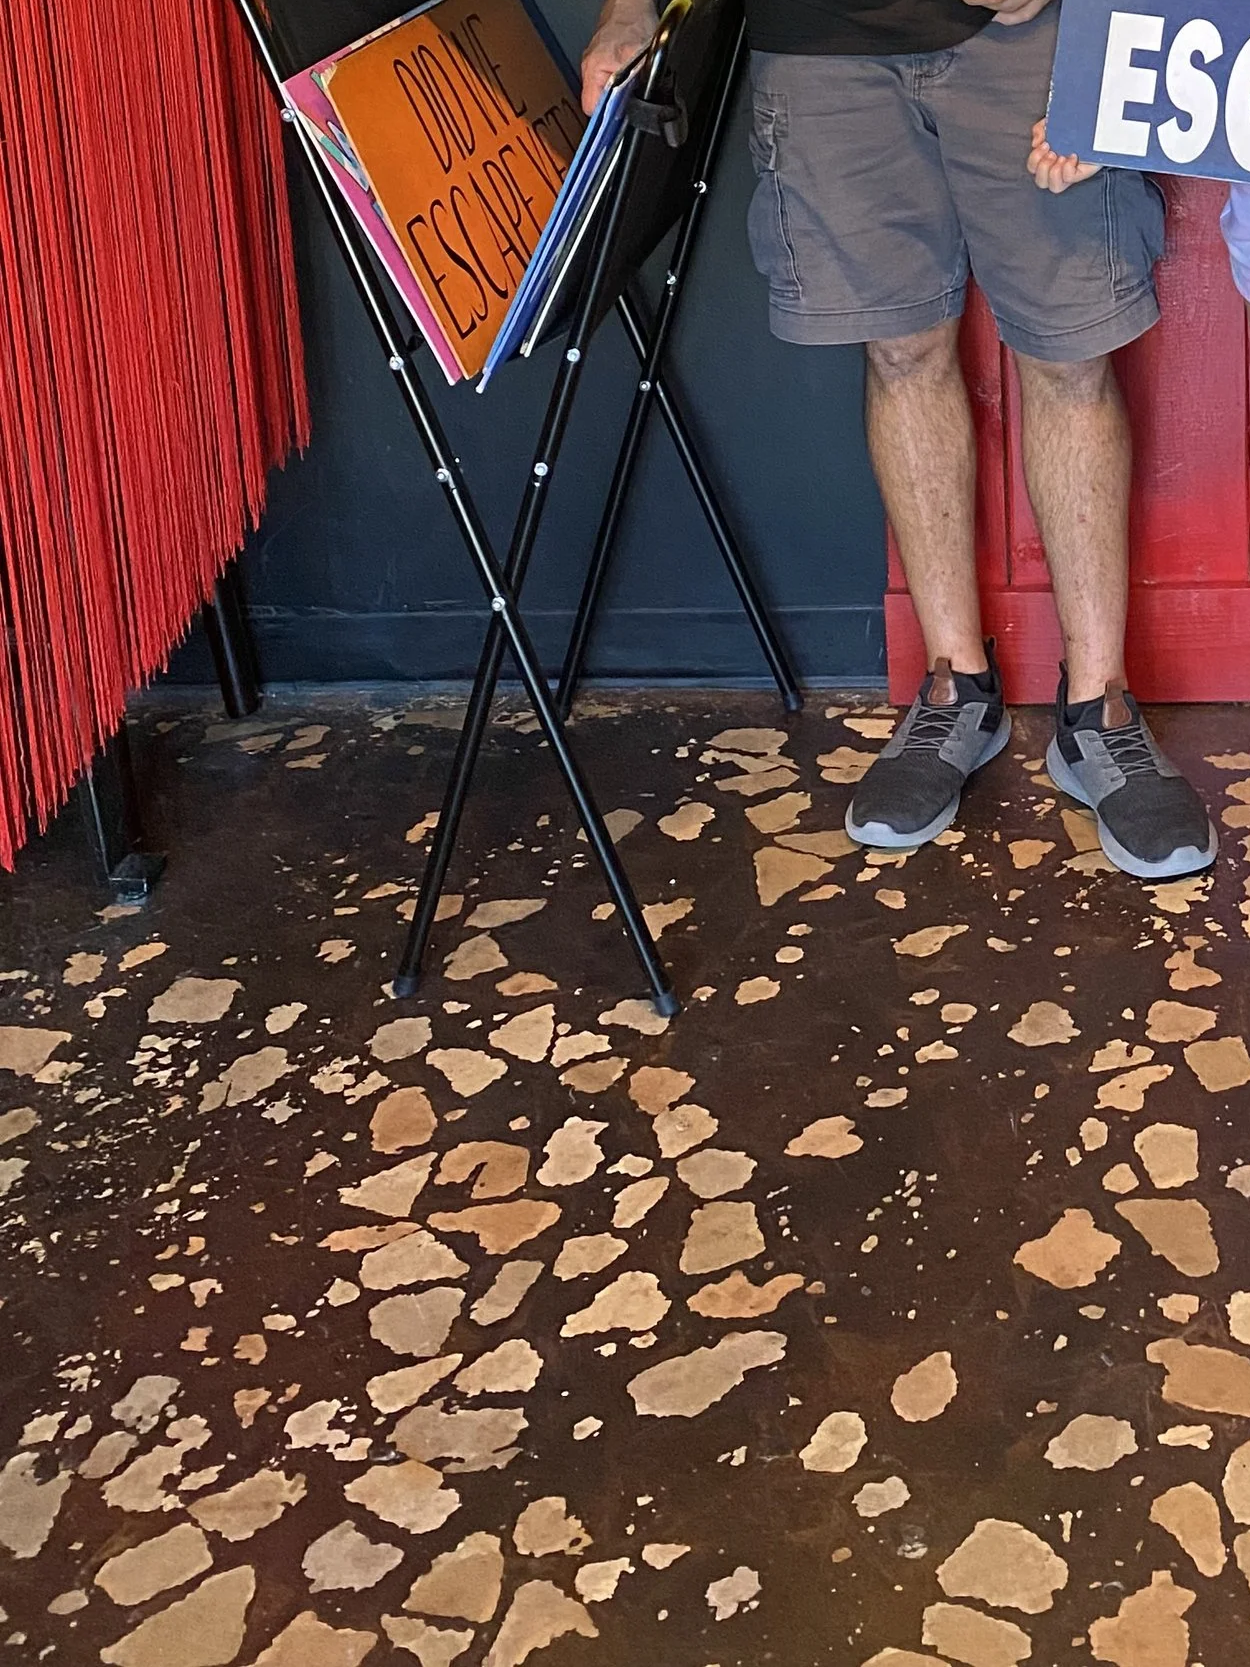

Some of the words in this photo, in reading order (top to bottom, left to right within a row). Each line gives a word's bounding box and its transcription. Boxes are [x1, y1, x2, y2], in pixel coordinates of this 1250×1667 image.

[393, 44, 476, 175] DID
[438, 13, 527, 136] WE
[406, 144, 544, 341] ESCAPE
